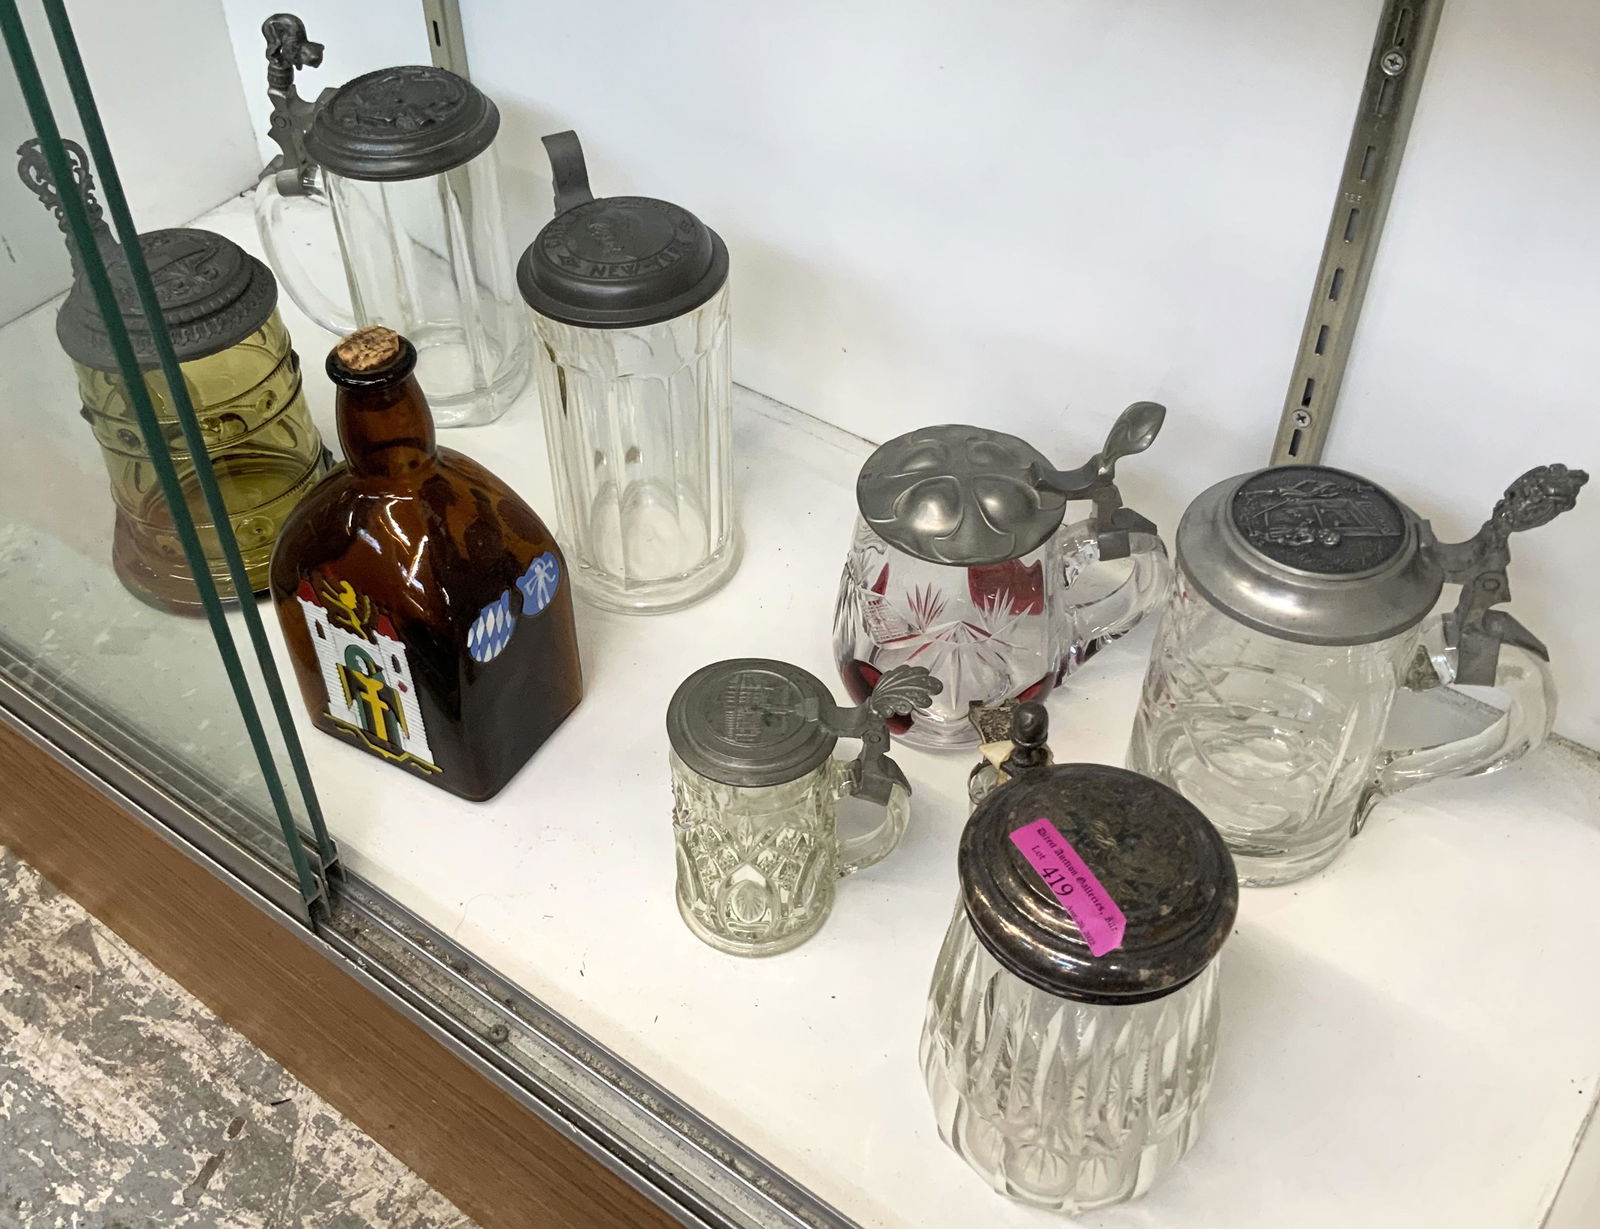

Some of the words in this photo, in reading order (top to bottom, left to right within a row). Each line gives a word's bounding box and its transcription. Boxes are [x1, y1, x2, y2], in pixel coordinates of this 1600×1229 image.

[1031, 845, 1046, 860] Lot
[1042, 867, 1074, 896] 419
[1037, 827, 1057, 849] Direct
[1055, 848, 1078, 875] Auction
